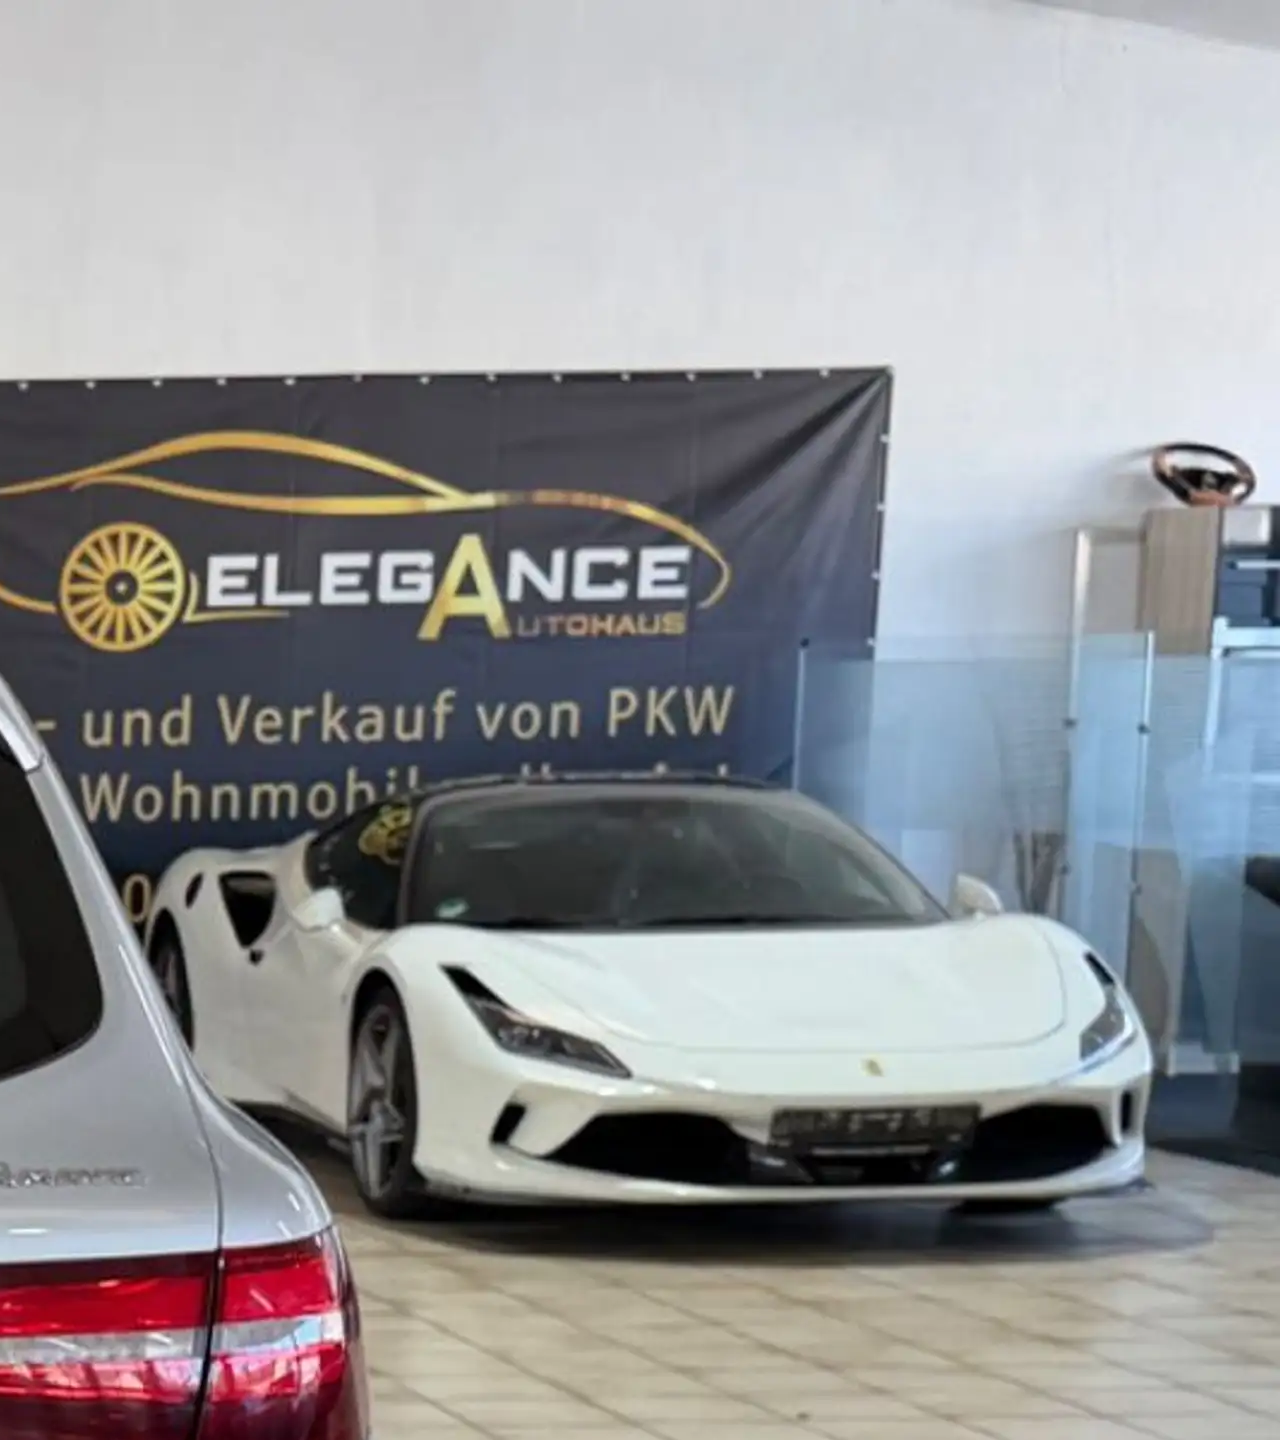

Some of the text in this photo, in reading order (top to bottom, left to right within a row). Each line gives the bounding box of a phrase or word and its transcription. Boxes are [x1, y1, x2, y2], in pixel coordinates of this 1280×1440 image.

[206, 533, 692, 641] ELEGANCE
[82, 686, 736, 746] und Verkauf von PKW
